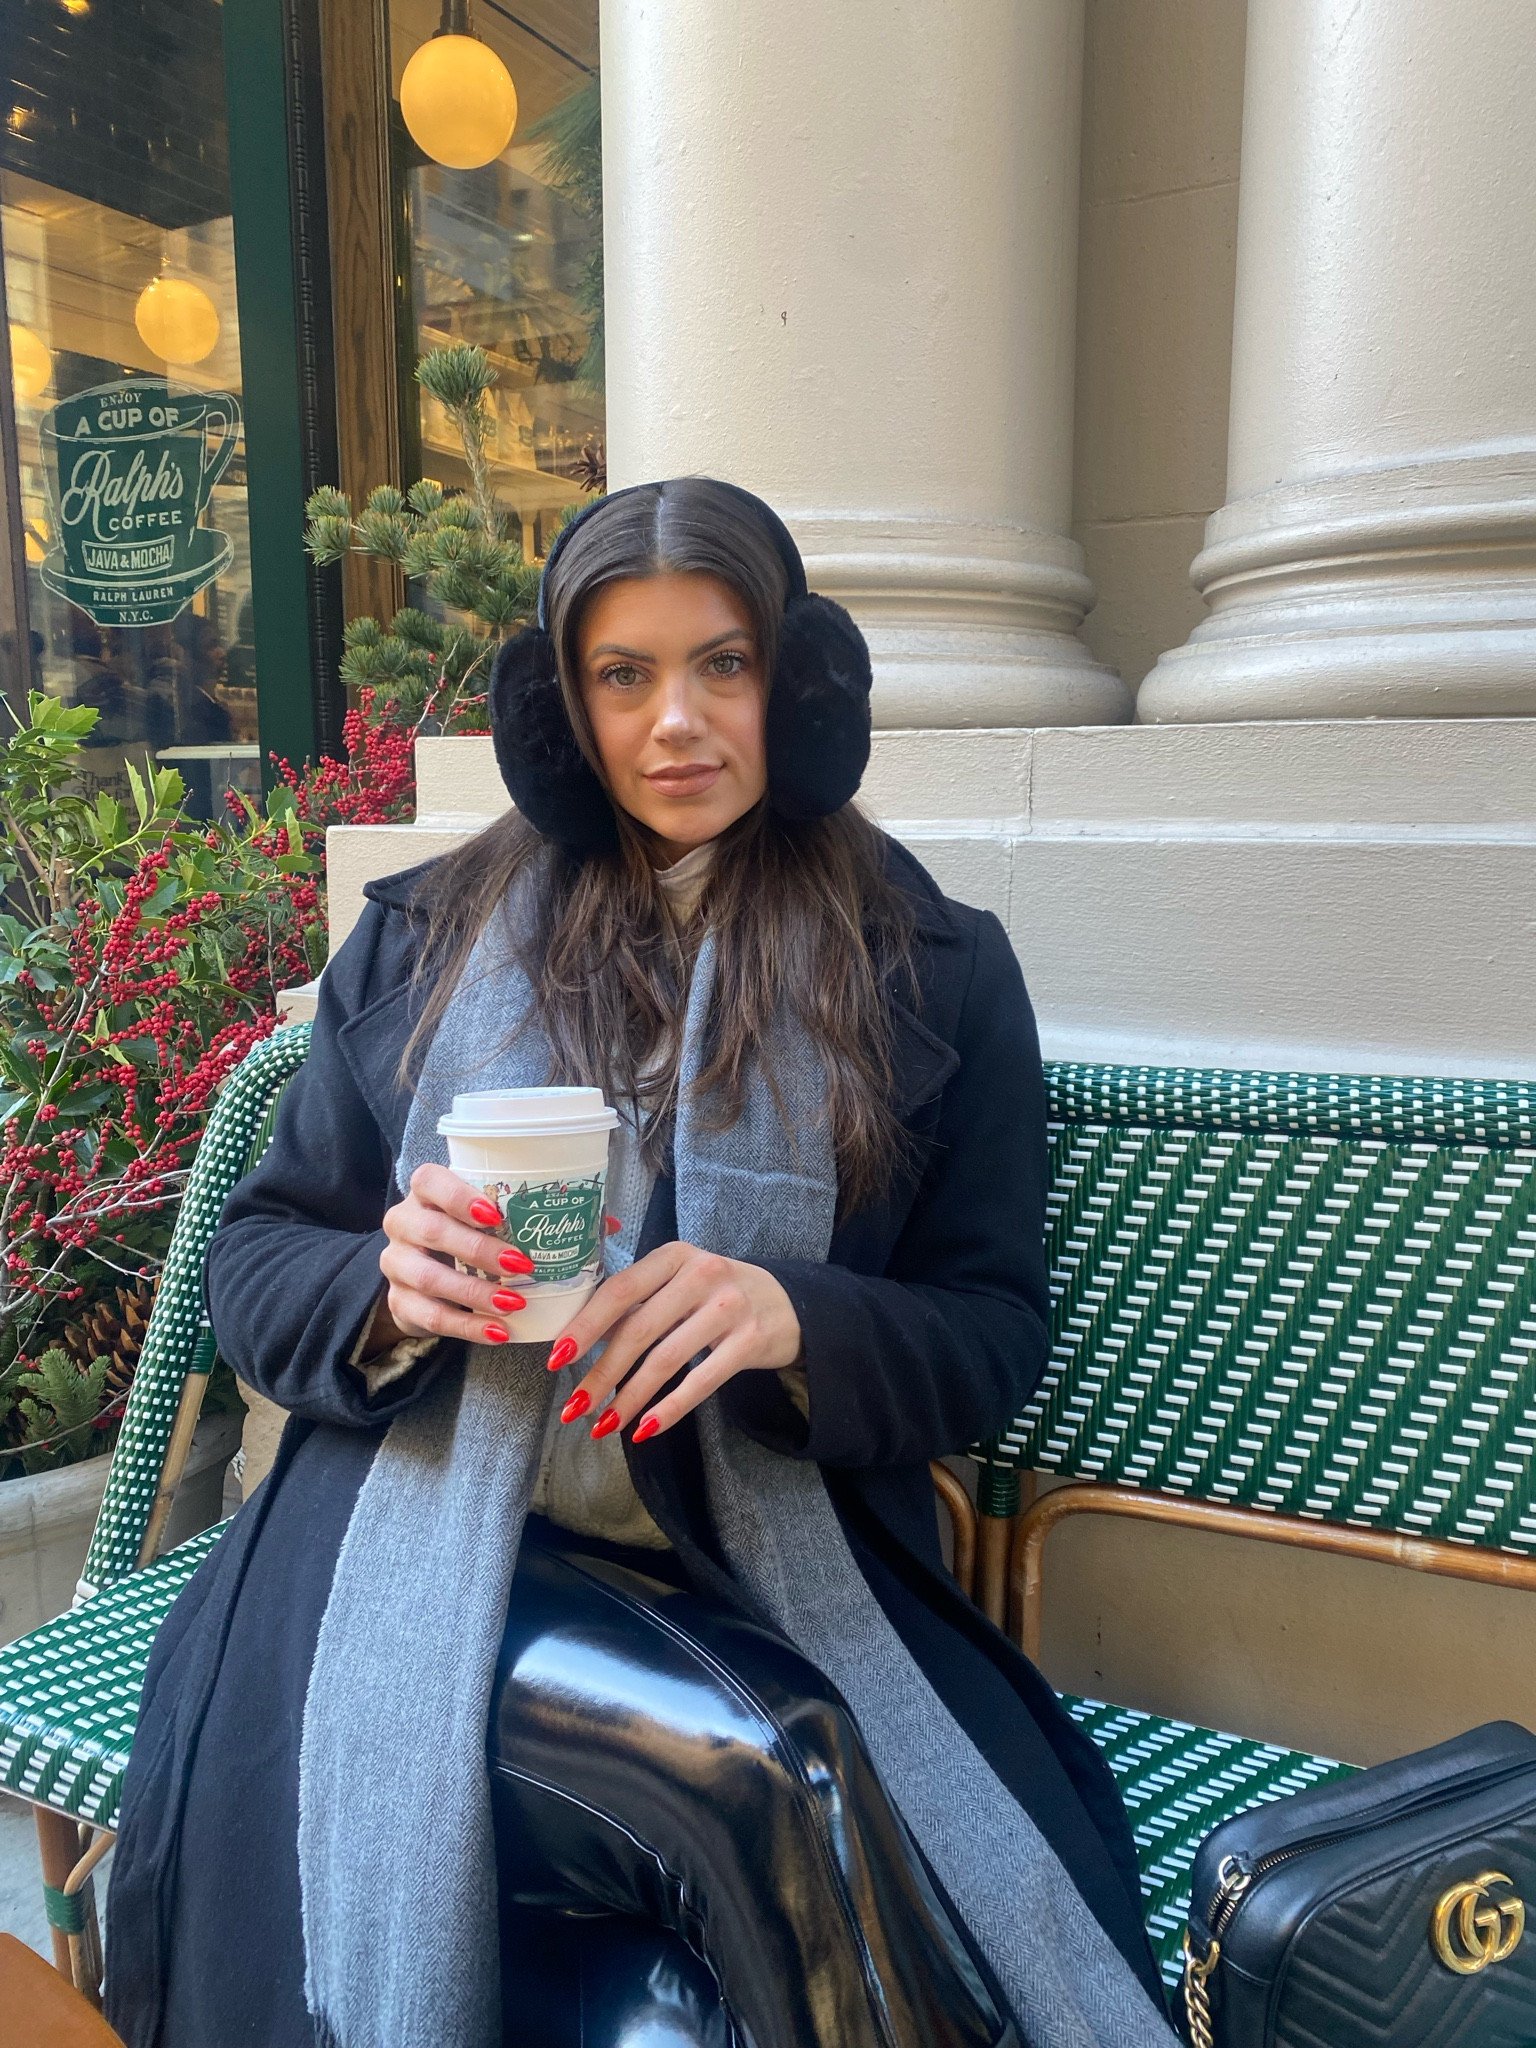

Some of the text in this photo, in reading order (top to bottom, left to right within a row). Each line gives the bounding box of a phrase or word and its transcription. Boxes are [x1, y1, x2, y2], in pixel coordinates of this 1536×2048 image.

[100, 392, 142, 408] ENJOY
[75, 406, 179, 438] A CUP OF
[61, 449, 184, 542] Ralph's
[108, 510, 183, 531] COFFEE
[88, 543, 170, 570] JAVA & MOCHA
[93, 586, 174, 602] RALPH LAUREN
[119, 610, 154, 623] N.Y.C.
[529, 1196, 585, 1209] A CUP OF
[517, 1212, 586, 1250] Ralph's
[546, 1234, 583, 1246] COFFEE
[532, 1252, 551, 1260] JAVA
